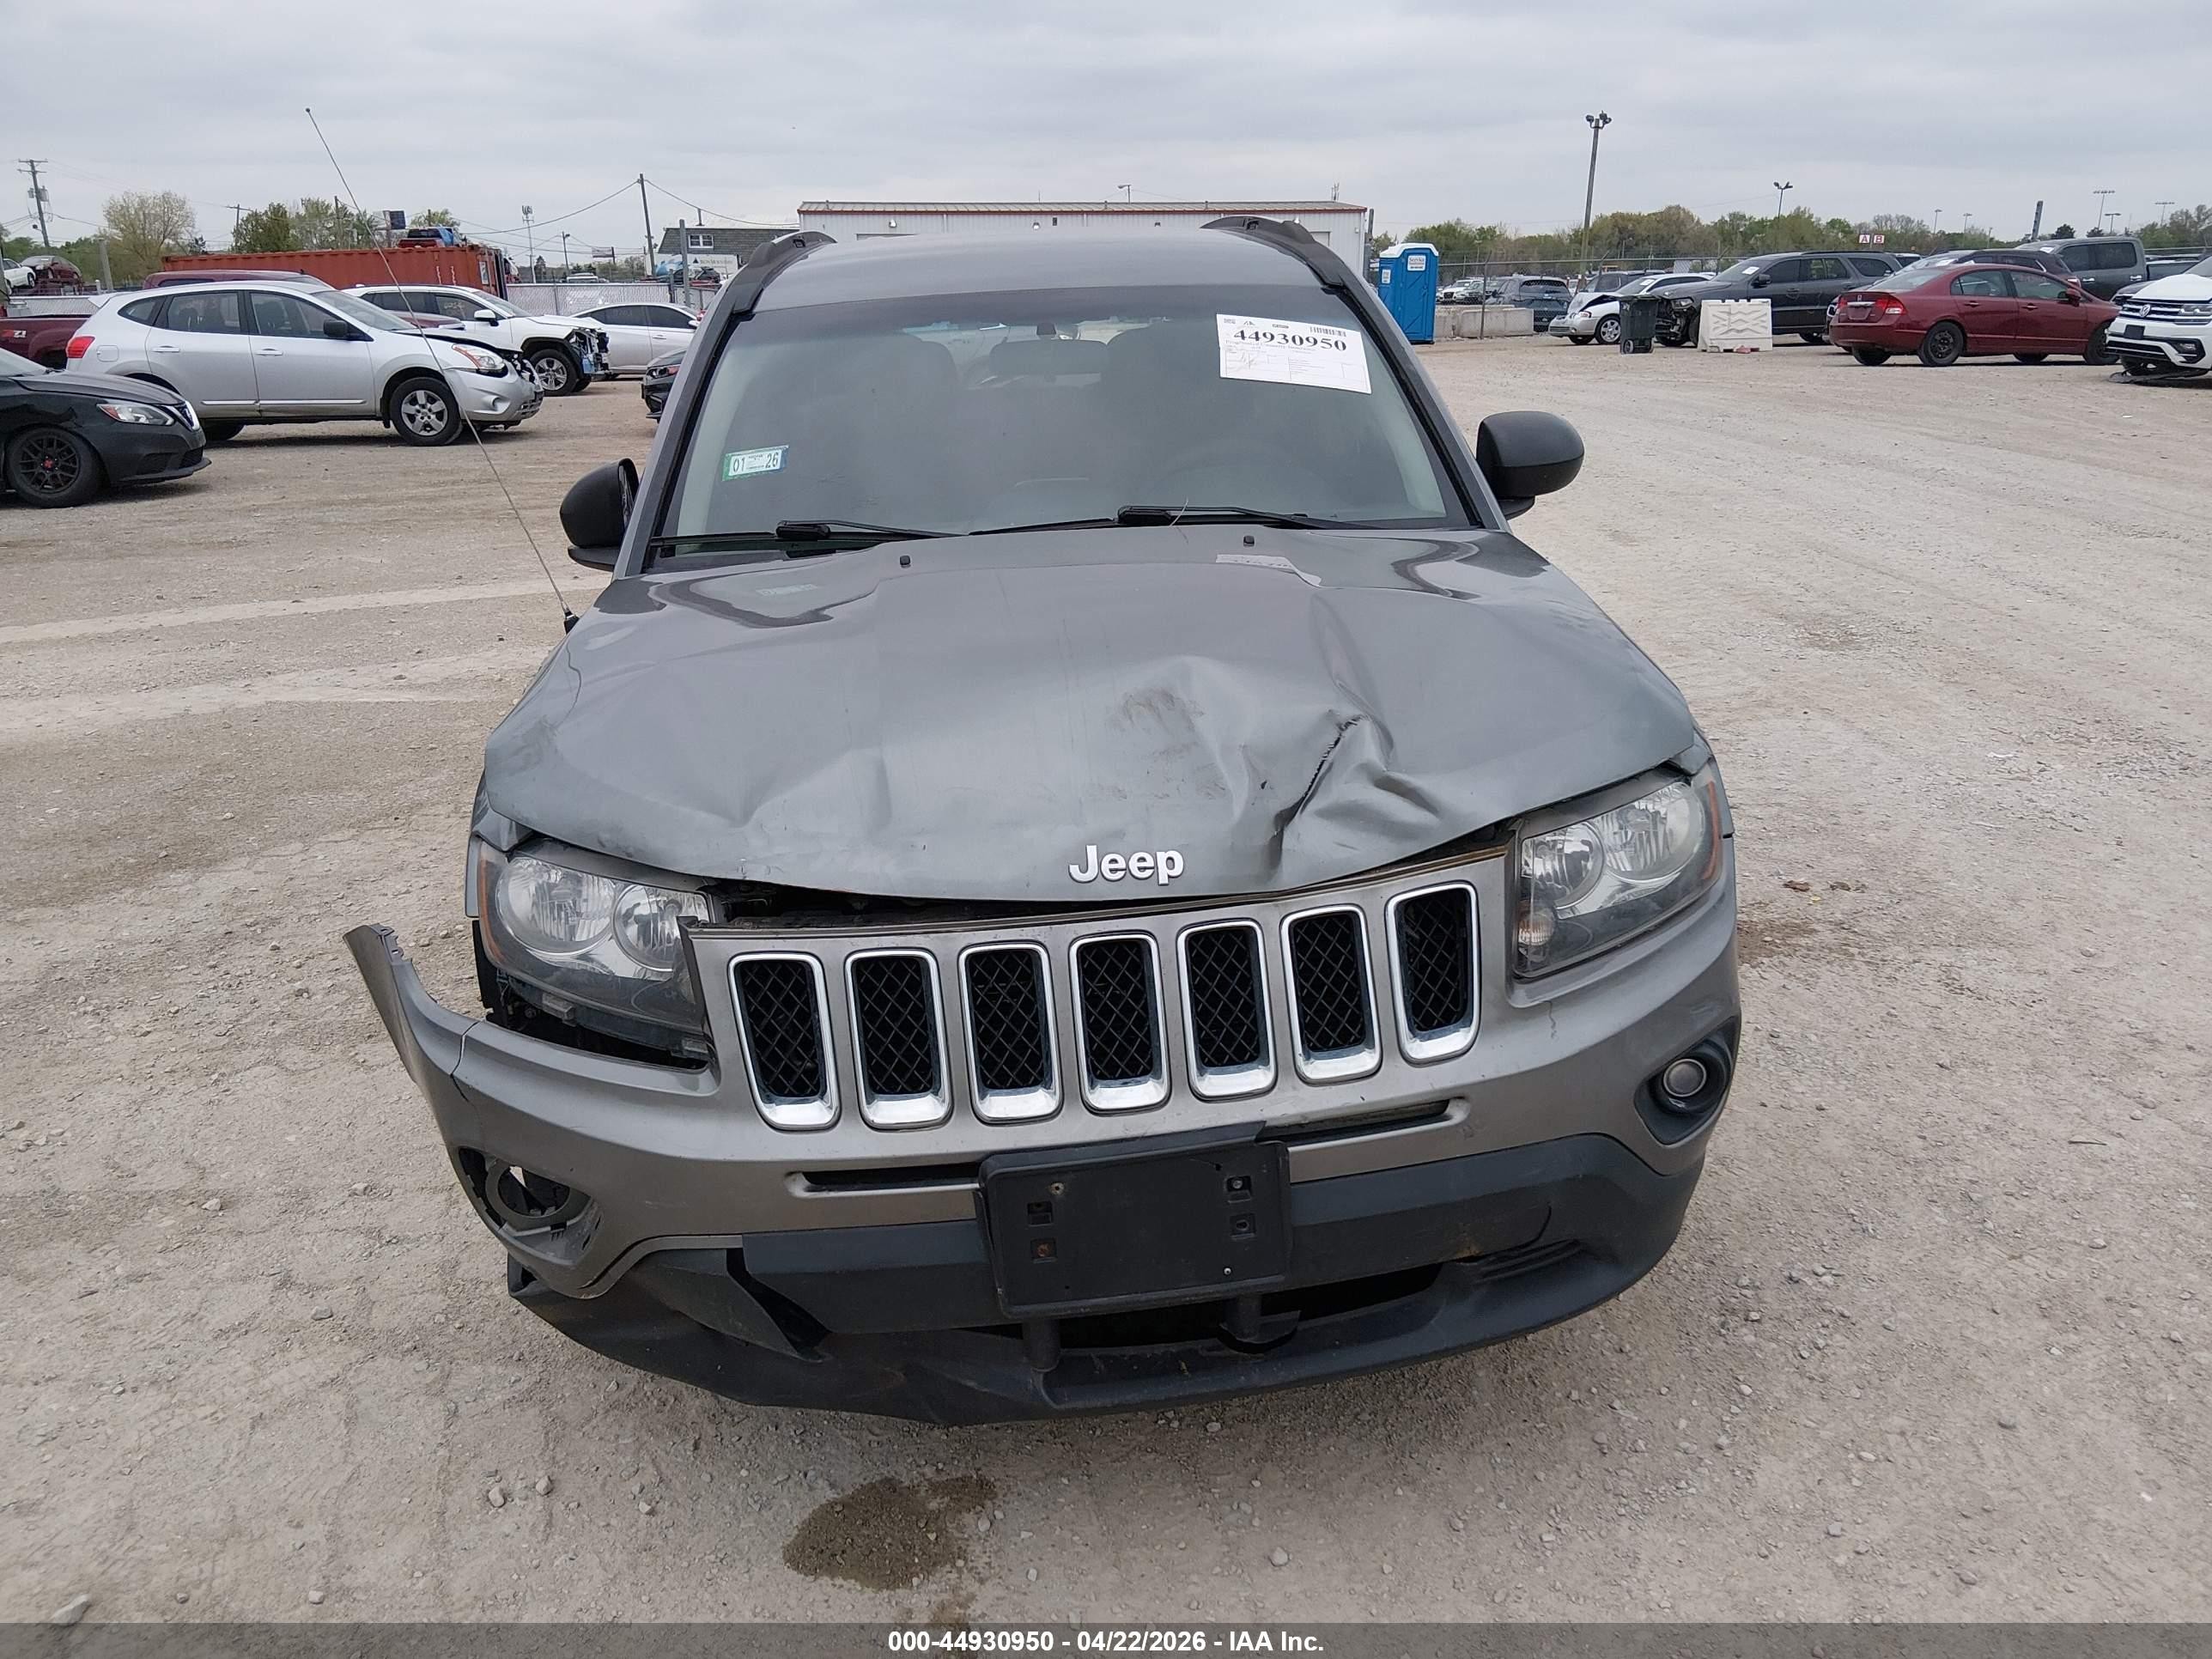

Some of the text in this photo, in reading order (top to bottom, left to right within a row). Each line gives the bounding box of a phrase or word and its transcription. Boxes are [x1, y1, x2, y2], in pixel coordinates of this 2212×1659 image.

[1233, 329, 1346, 351] 44930950
[732, 457, 745, 473] 01
[765, 452, 779, 469] 26
[1068, 844, 1184, 886] Jeep
